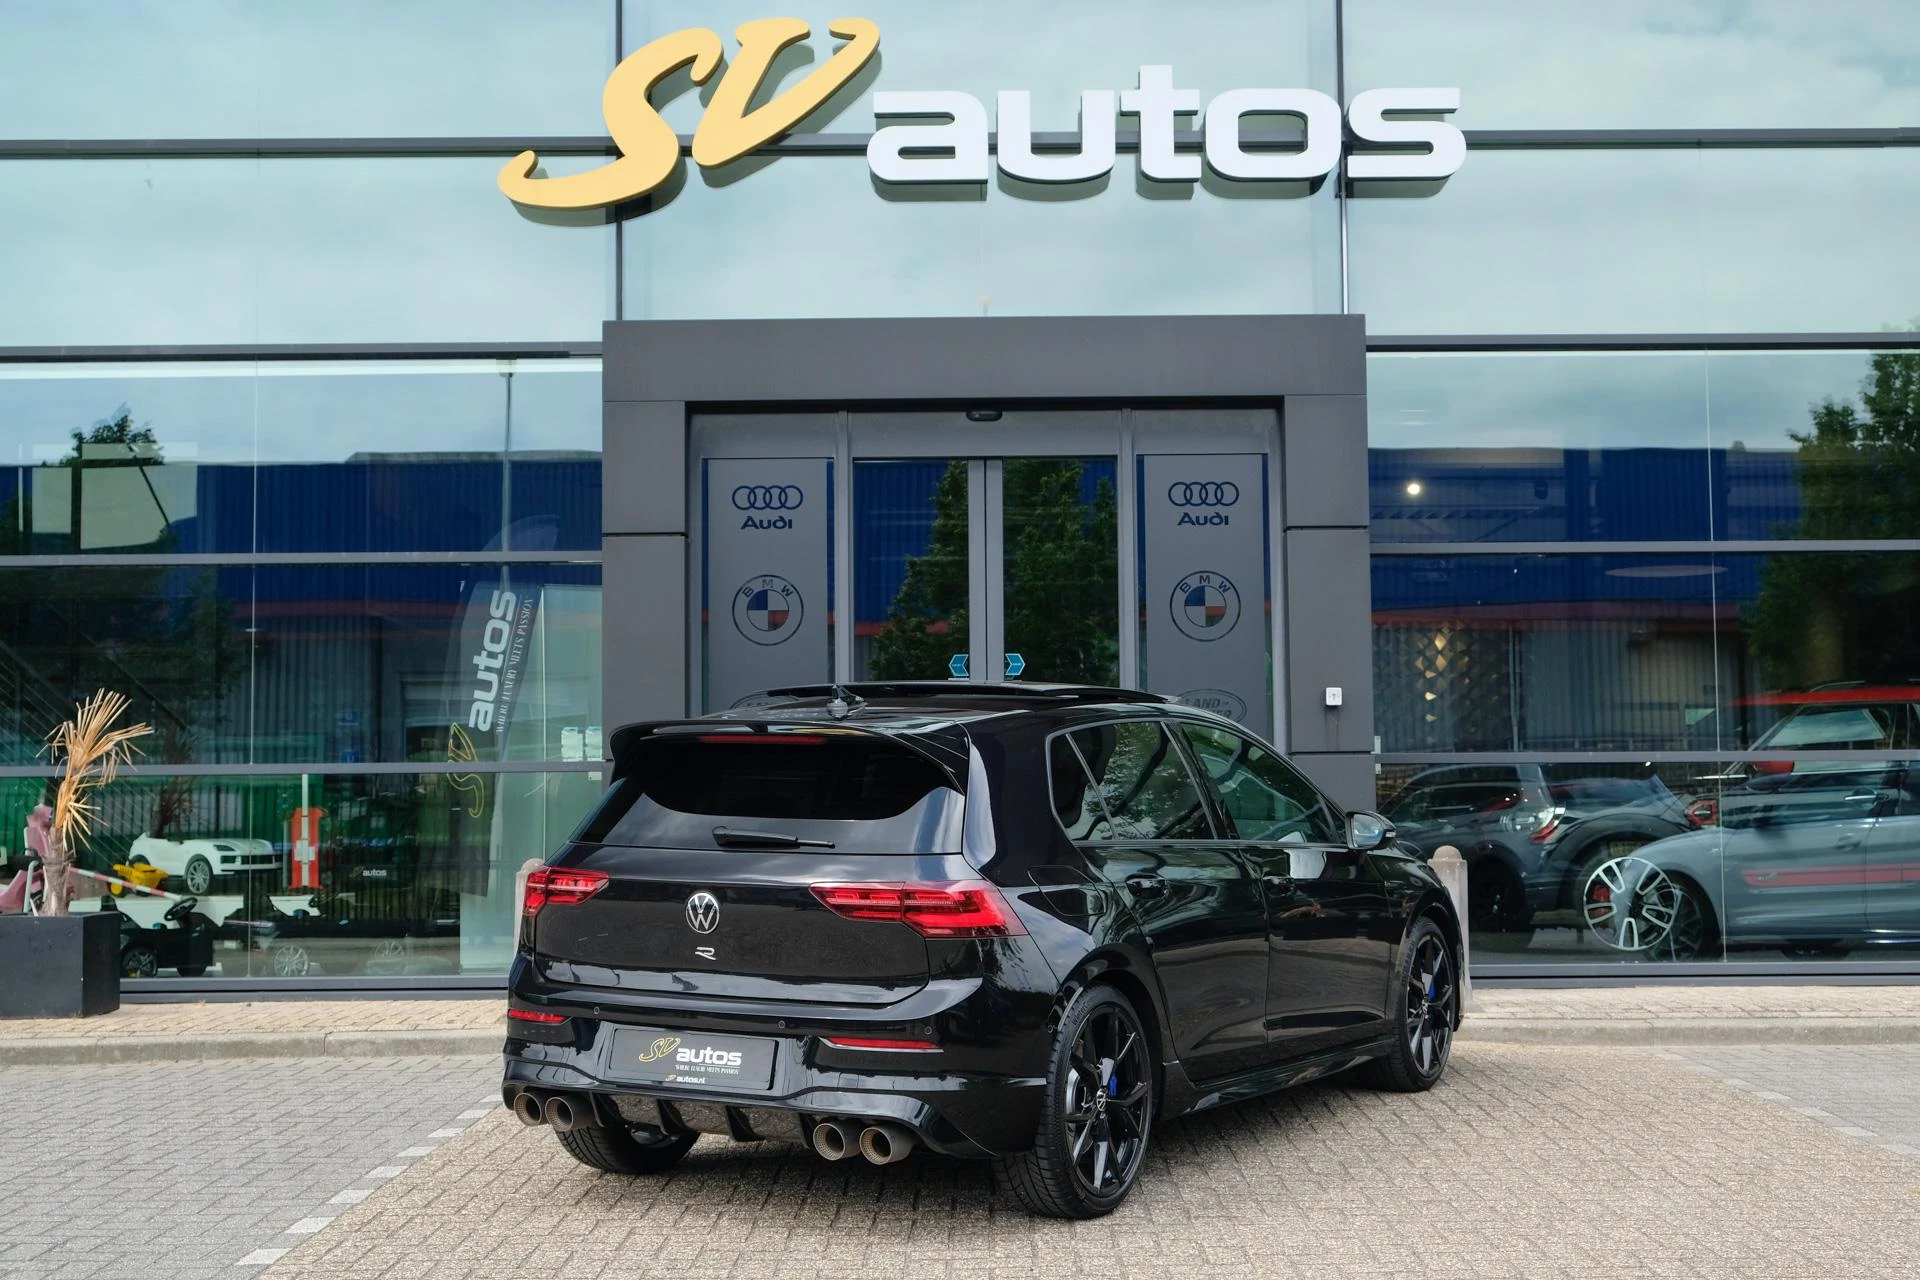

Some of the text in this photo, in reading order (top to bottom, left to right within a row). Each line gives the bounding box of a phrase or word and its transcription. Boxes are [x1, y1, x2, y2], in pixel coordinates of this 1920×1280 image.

[866, 65, 1467, 184] autos
[740, 515, 793, 530] Audi
[1177, 511, 1229, 526] Audi
[468, 589, 517, 732] autos
[676, 1046, 742, 1066] autos
